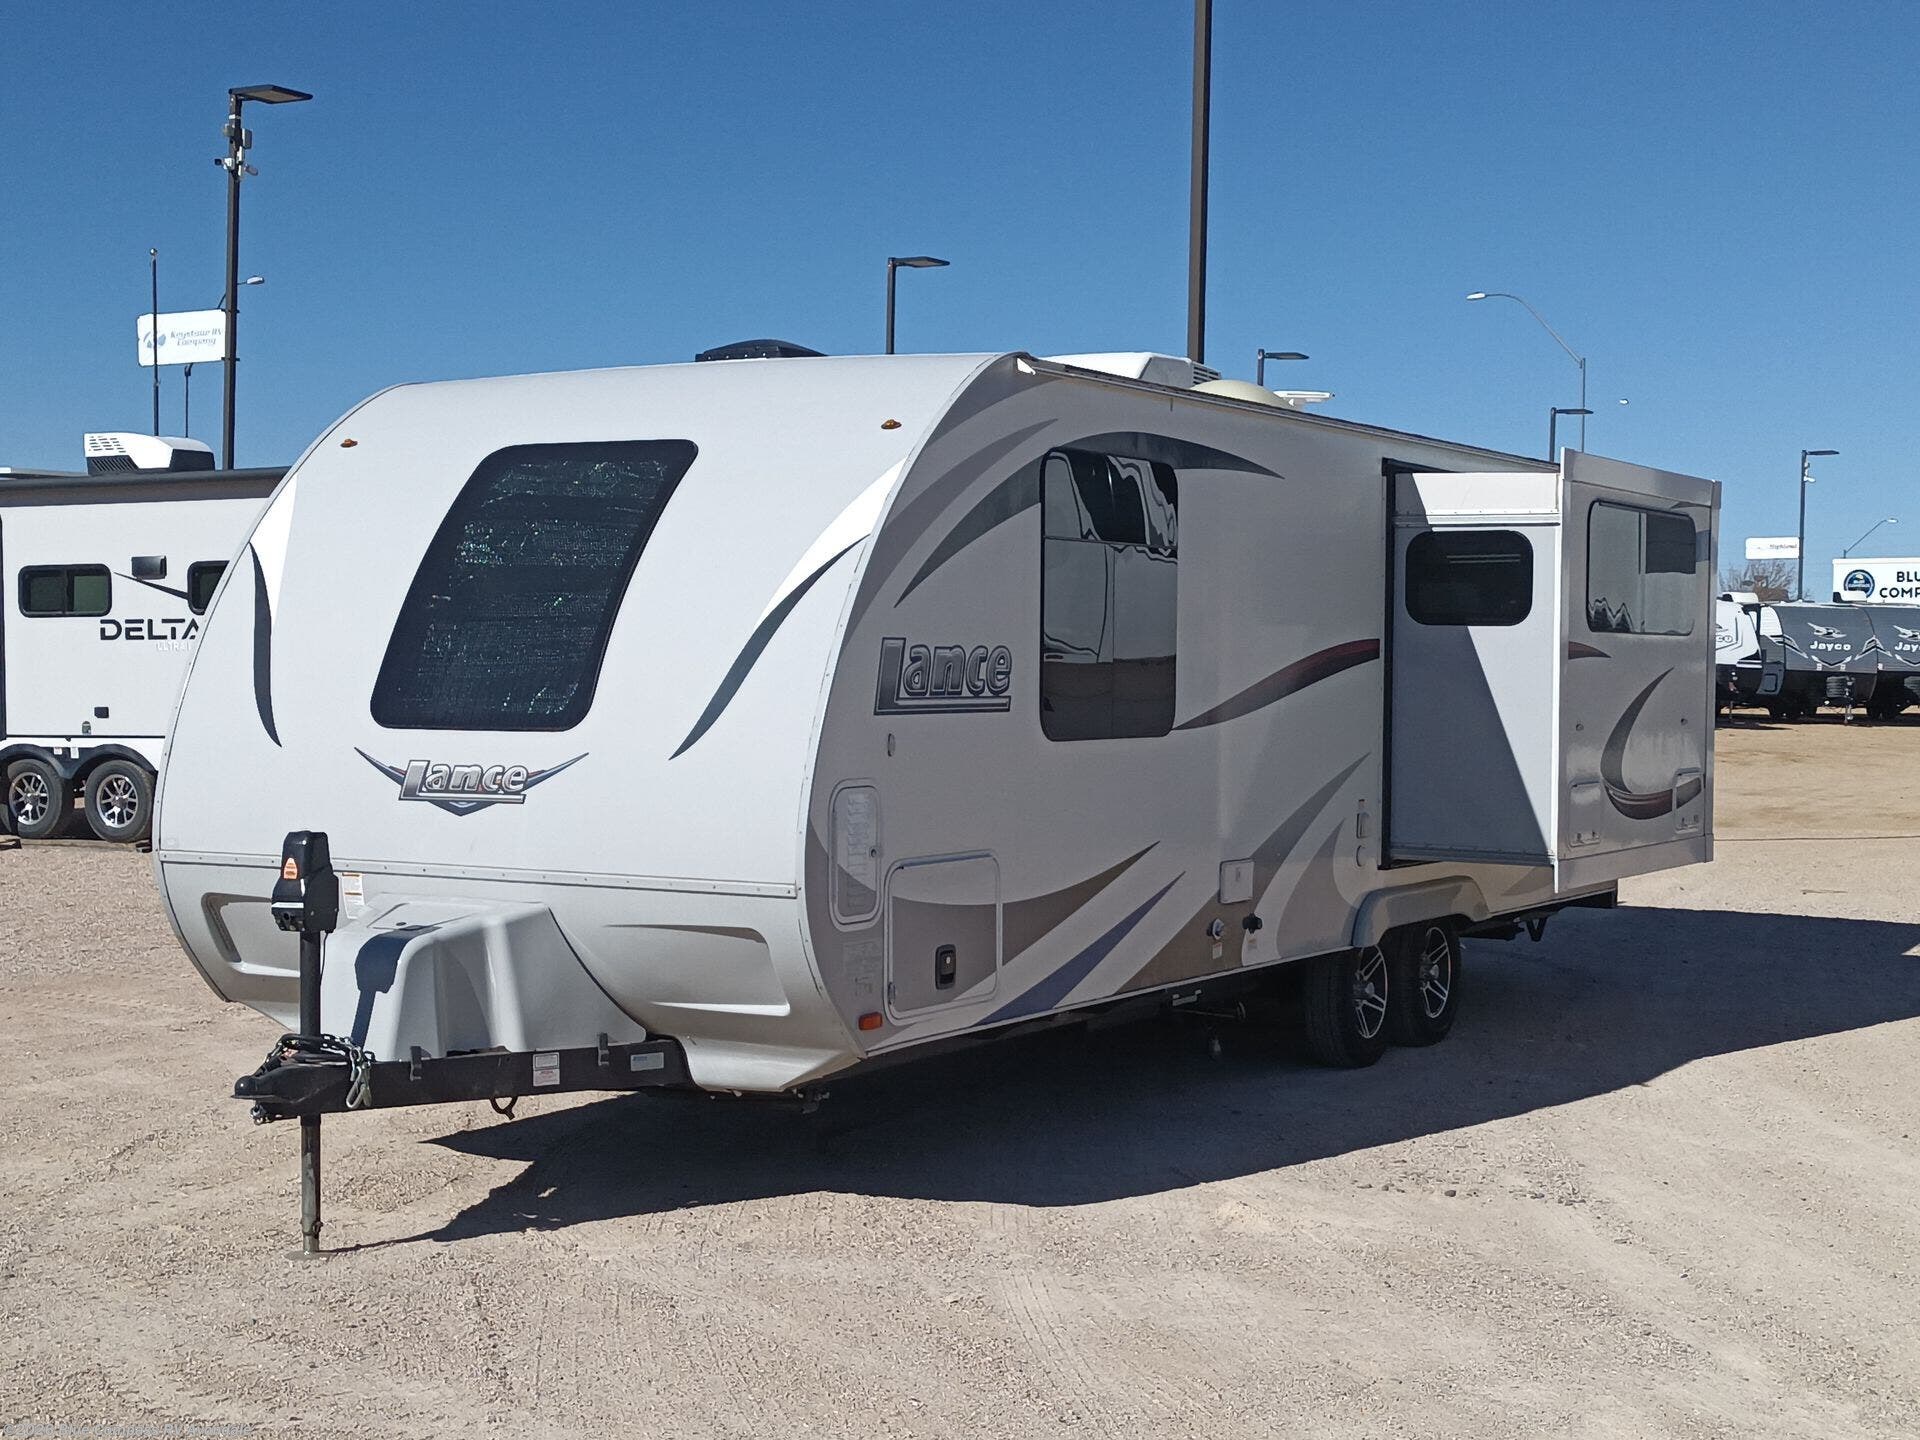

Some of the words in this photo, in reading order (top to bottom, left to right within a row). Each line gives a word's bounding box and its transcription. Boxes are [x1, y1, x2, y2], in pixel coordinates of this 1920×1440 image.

[100, 618, 199, 640] DELTA
[1809, 641, 1851, 651] Jayco
[1894, 641, 1920, 653] Jay
[873, 637, 1012, 715] Lance
[399, 760, 529, 804] Lance
